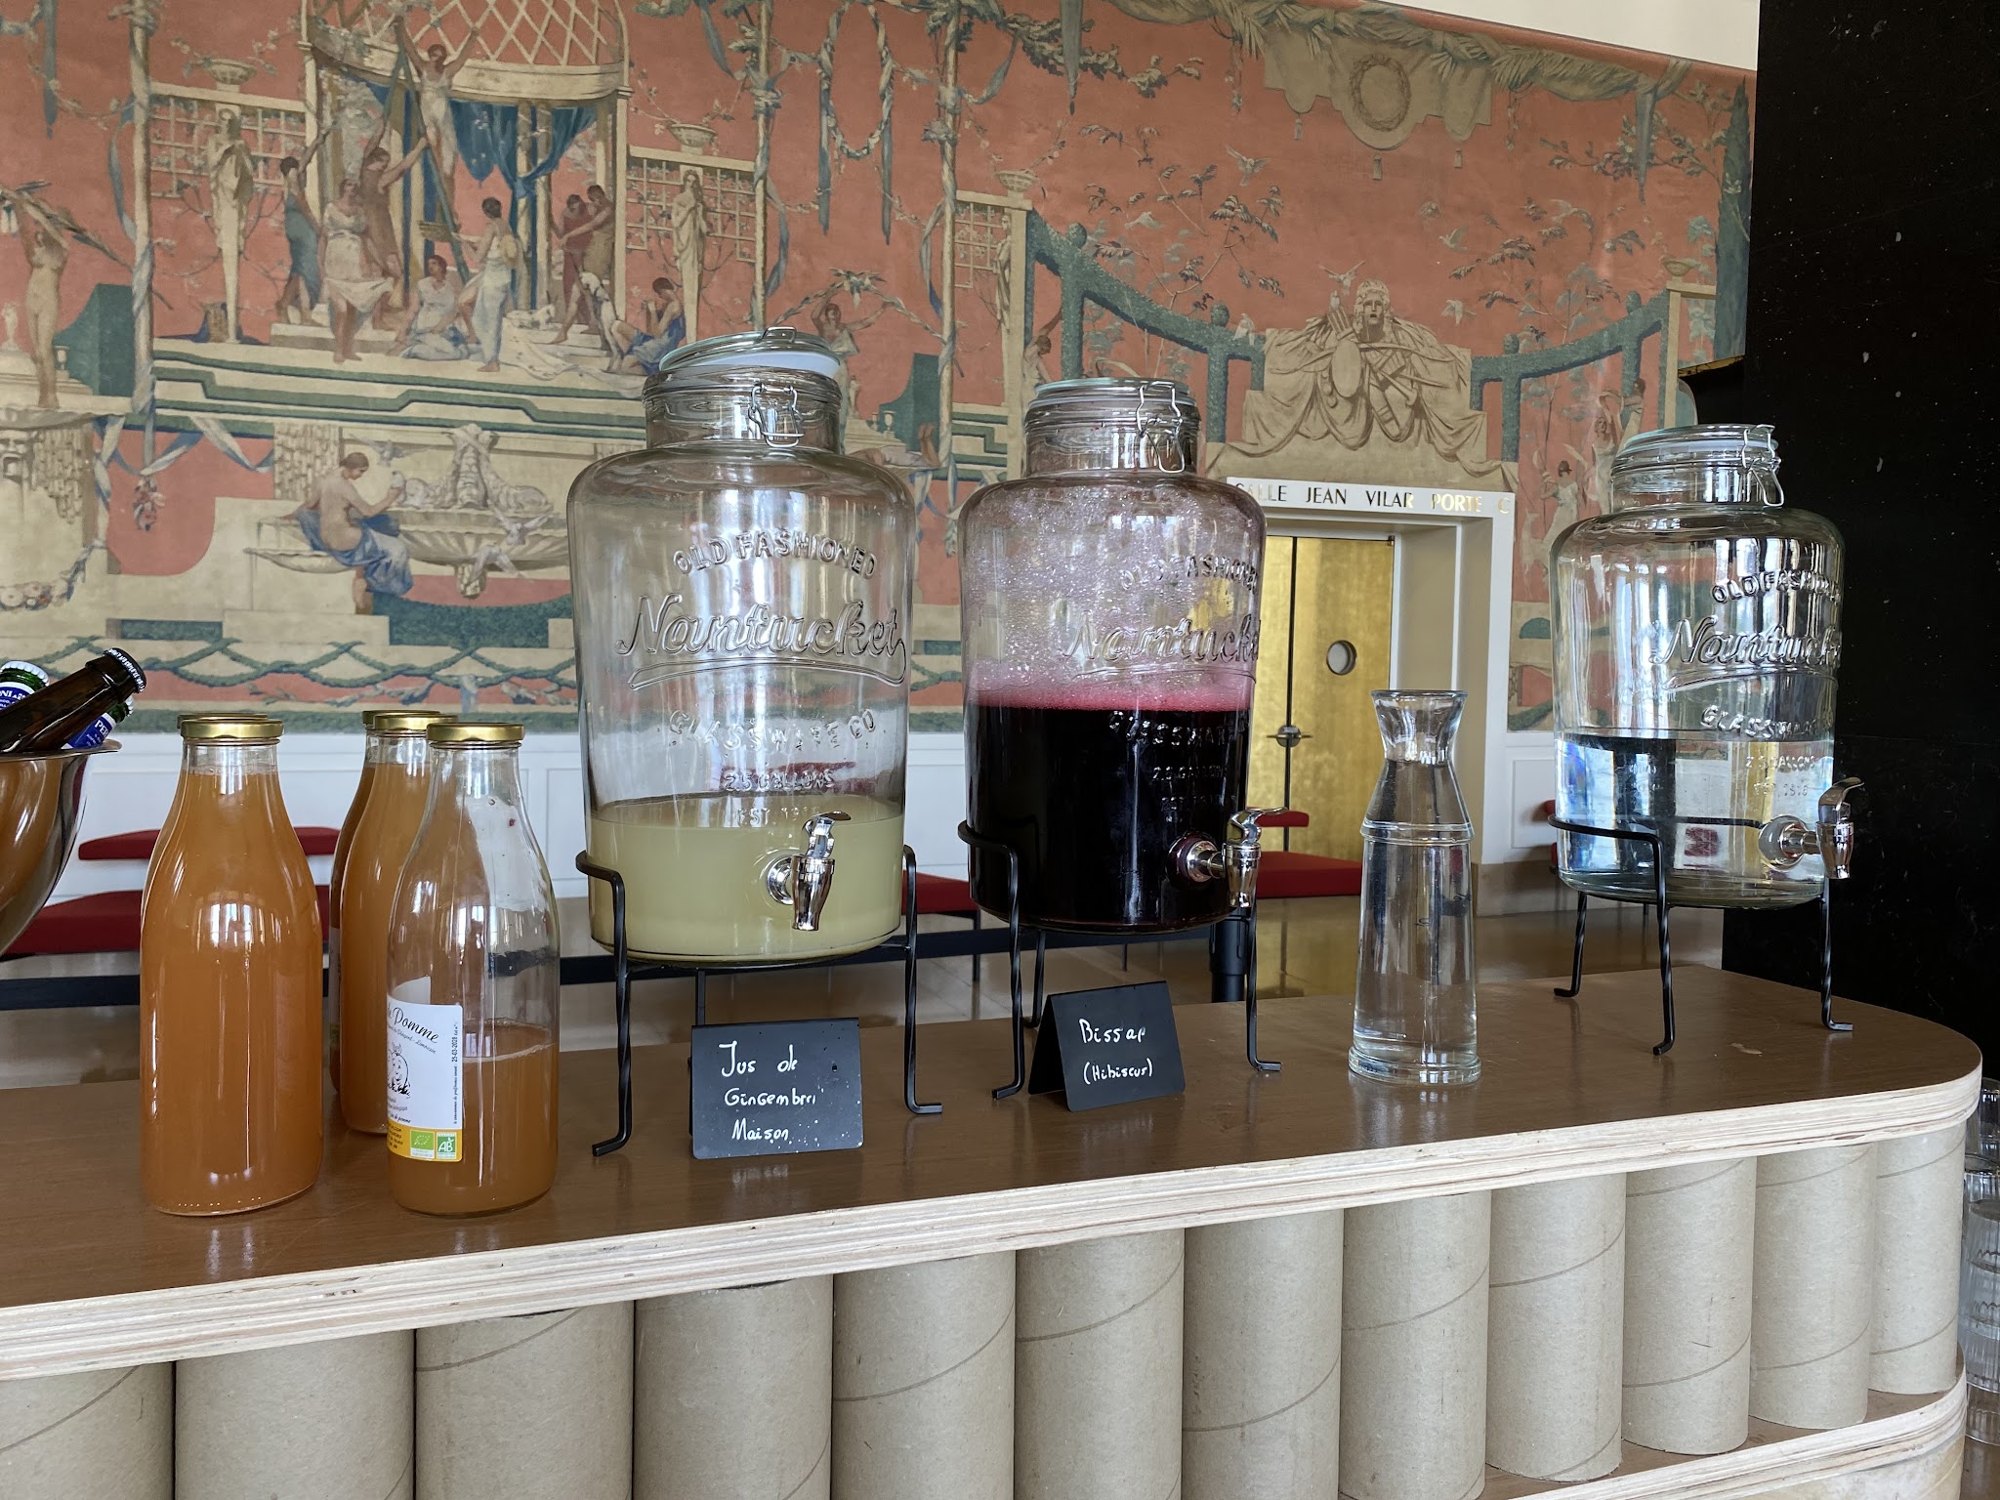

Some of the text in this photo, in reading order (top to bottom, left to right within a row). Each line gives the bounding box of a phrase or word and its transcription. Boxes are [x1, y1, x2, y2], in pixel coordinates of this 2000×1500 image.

[1305, 486, 1347, 505] JEAN
[1365, 489, 1414, 509] VILAR
[1431, 493, 1483, 513] PORTE
[1497, 496, 1511, 514] C
[673, 526, 878, 580] OLD FASHIONED
[1711, 575, 1760, 605] OLD
[615, 592, 907, 662] Nantucket
[393, 1007, 440, 1044] Pomme
[1079, 1018, 1146, 1044] Bissap
[719, 1040, 757, 1077] Jus
[1083, 1058, 1153, 1085] (Hibiscus)
[732, 1118, 789, 1140] Maison
[438, 1140, 454, 1152] AB
